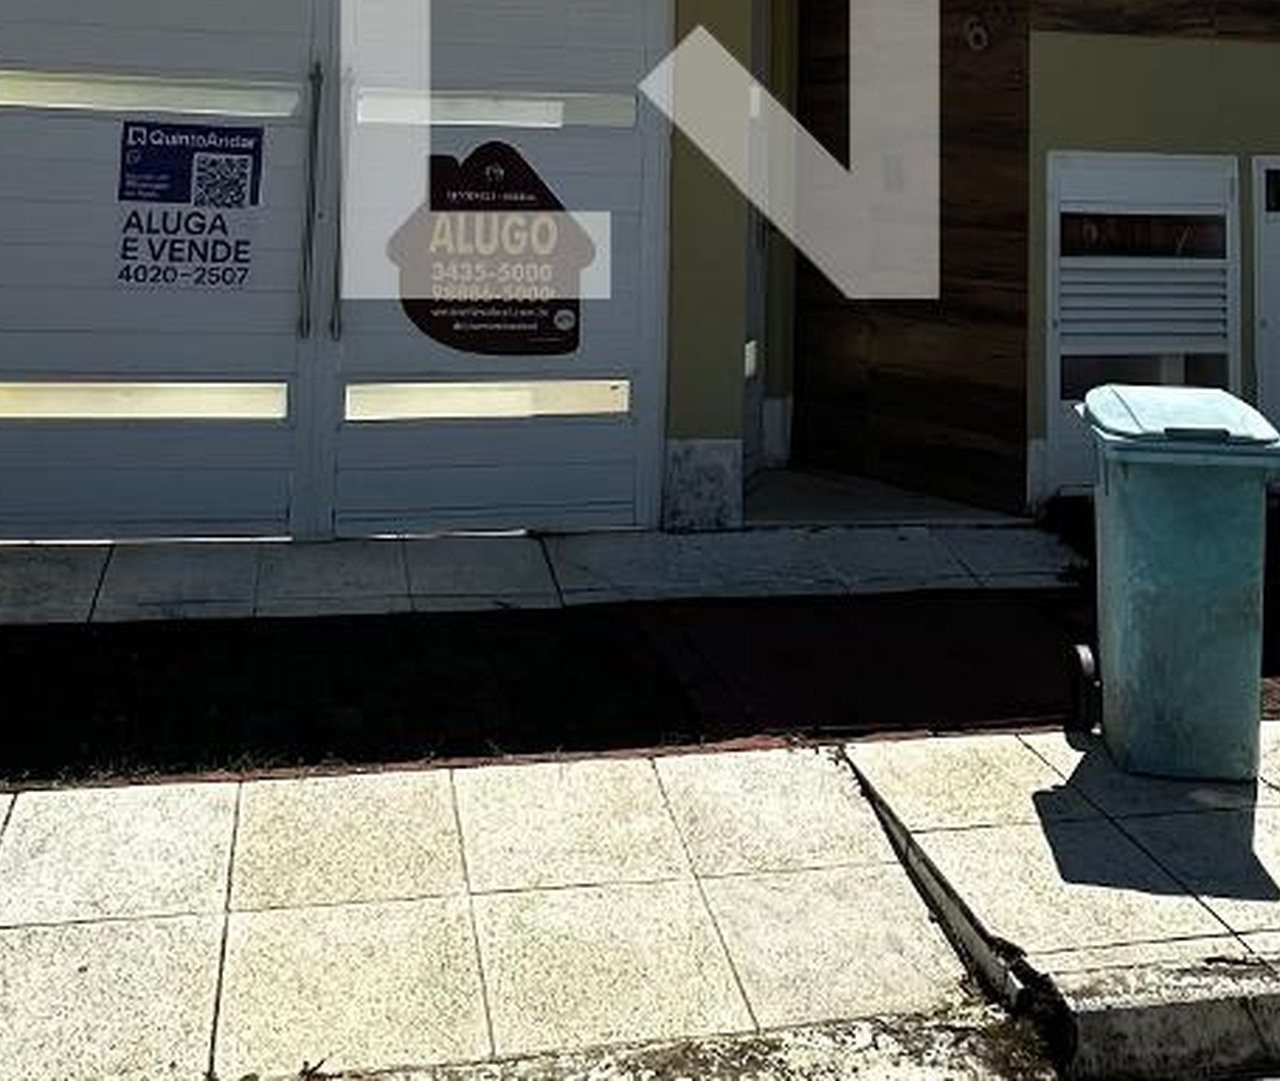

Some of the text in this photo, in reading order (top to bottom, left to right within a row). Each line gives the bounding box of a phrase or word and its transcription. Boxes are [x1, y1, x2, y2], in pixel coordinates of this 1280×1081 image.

[149, 128, 256, 149] QuintoAndar
[122, 210, 228, 236] ALUGA
[430, 211, 558, 256] ALUGO
[121, 237, 251, 263] E VENDE
[118, 264, 250, 286] 4020-2507
[430, 263, 553, 283] 3435-5000
